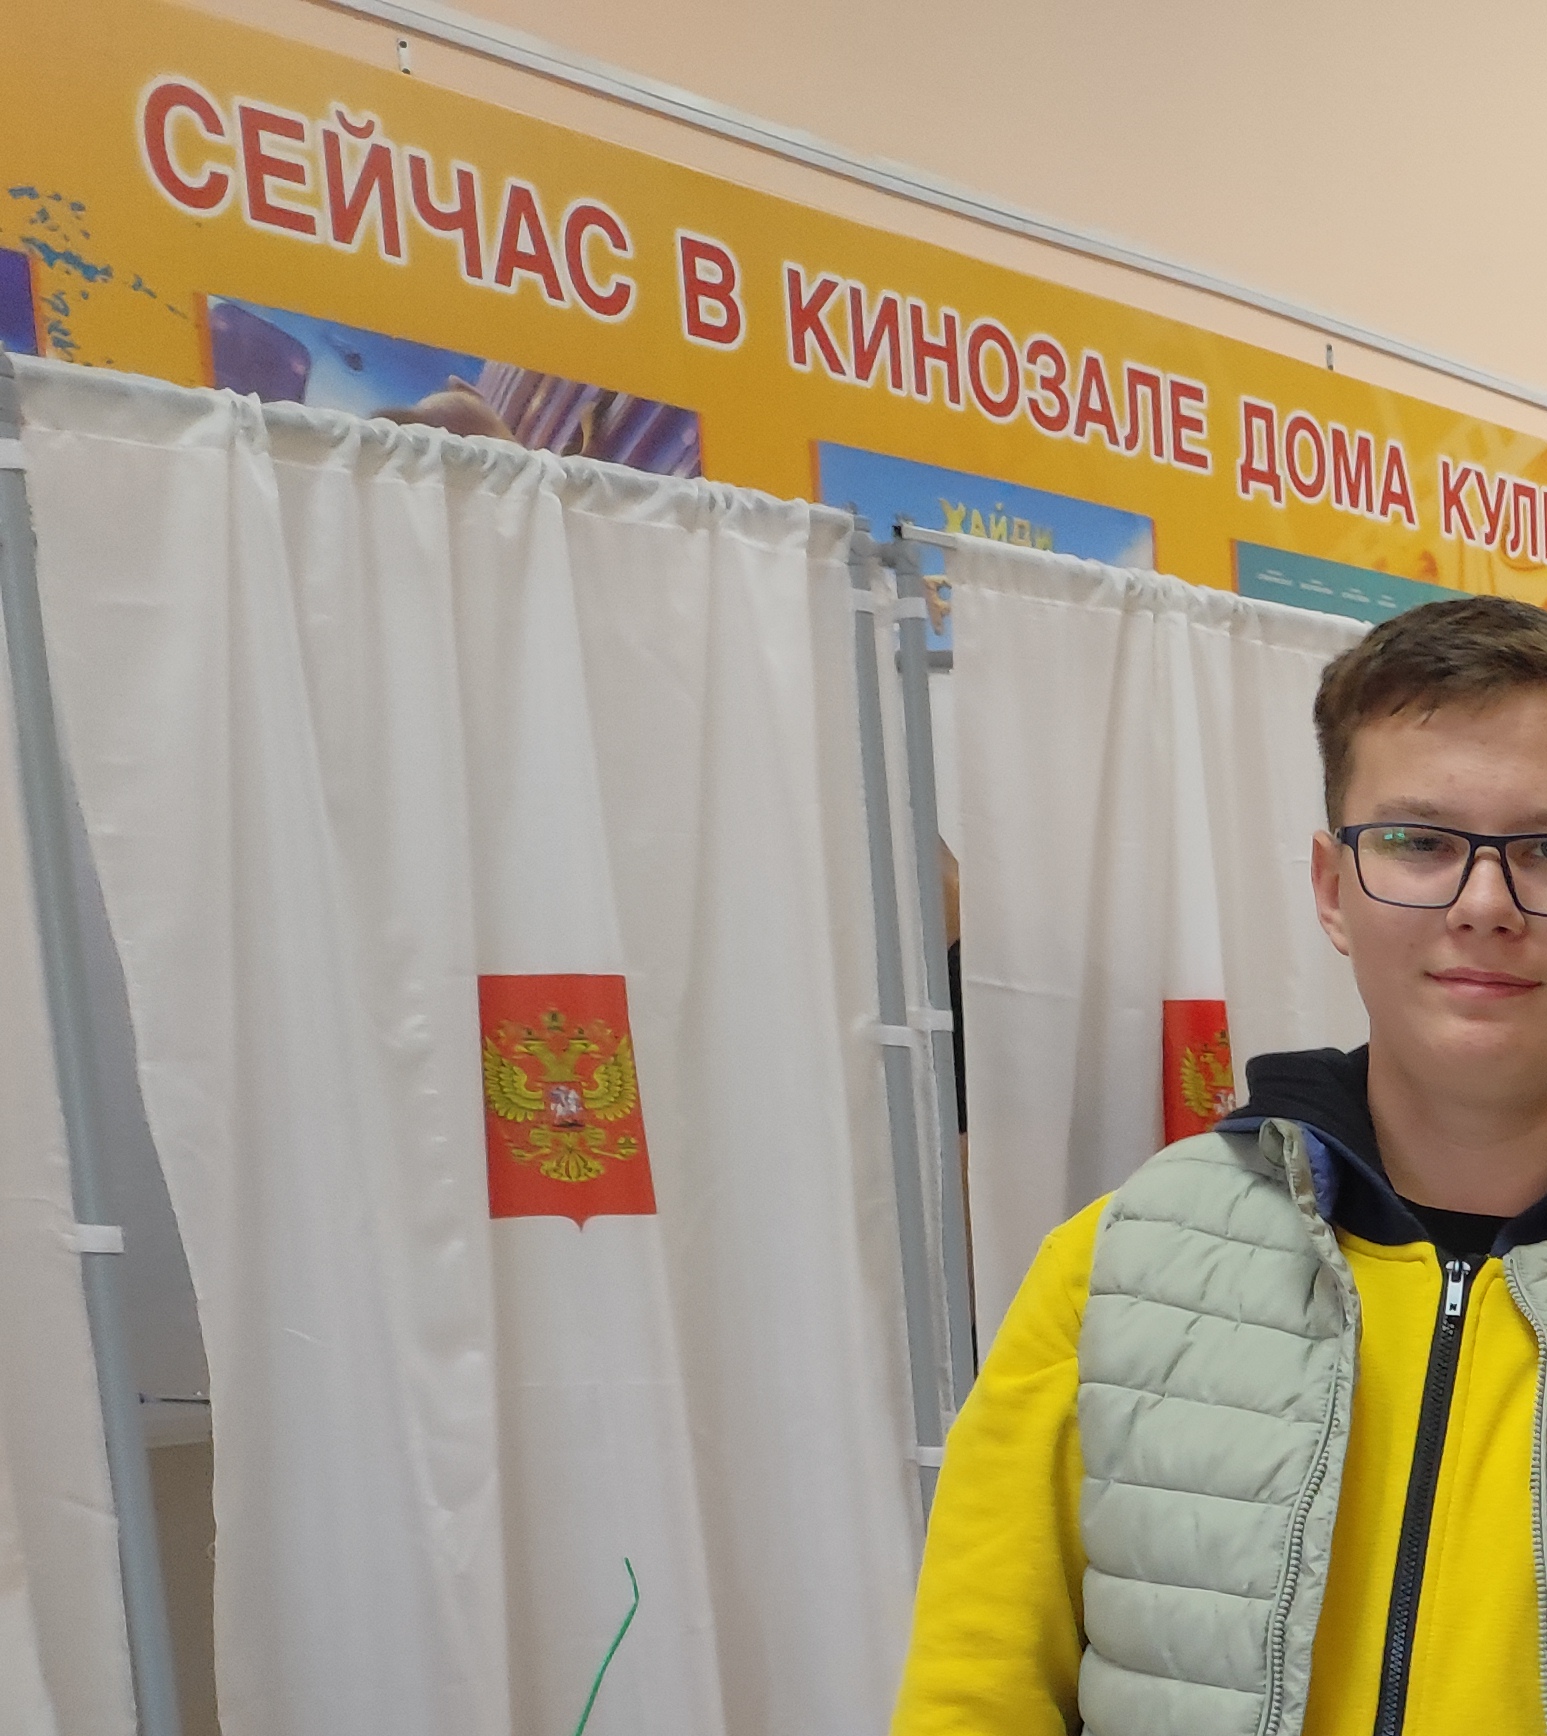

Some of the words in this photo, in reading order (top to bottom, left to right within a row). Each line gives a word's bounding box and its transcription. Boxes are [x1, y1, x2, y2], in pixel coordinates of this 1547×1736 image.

[144, 82, 631, 317] СЕЙЧАС
[679, 235, 742, 345] В
[786, 267, 1209, 470] КИНОЗАЛЕ
[1240, 401, 1416, 526] ДОМА
